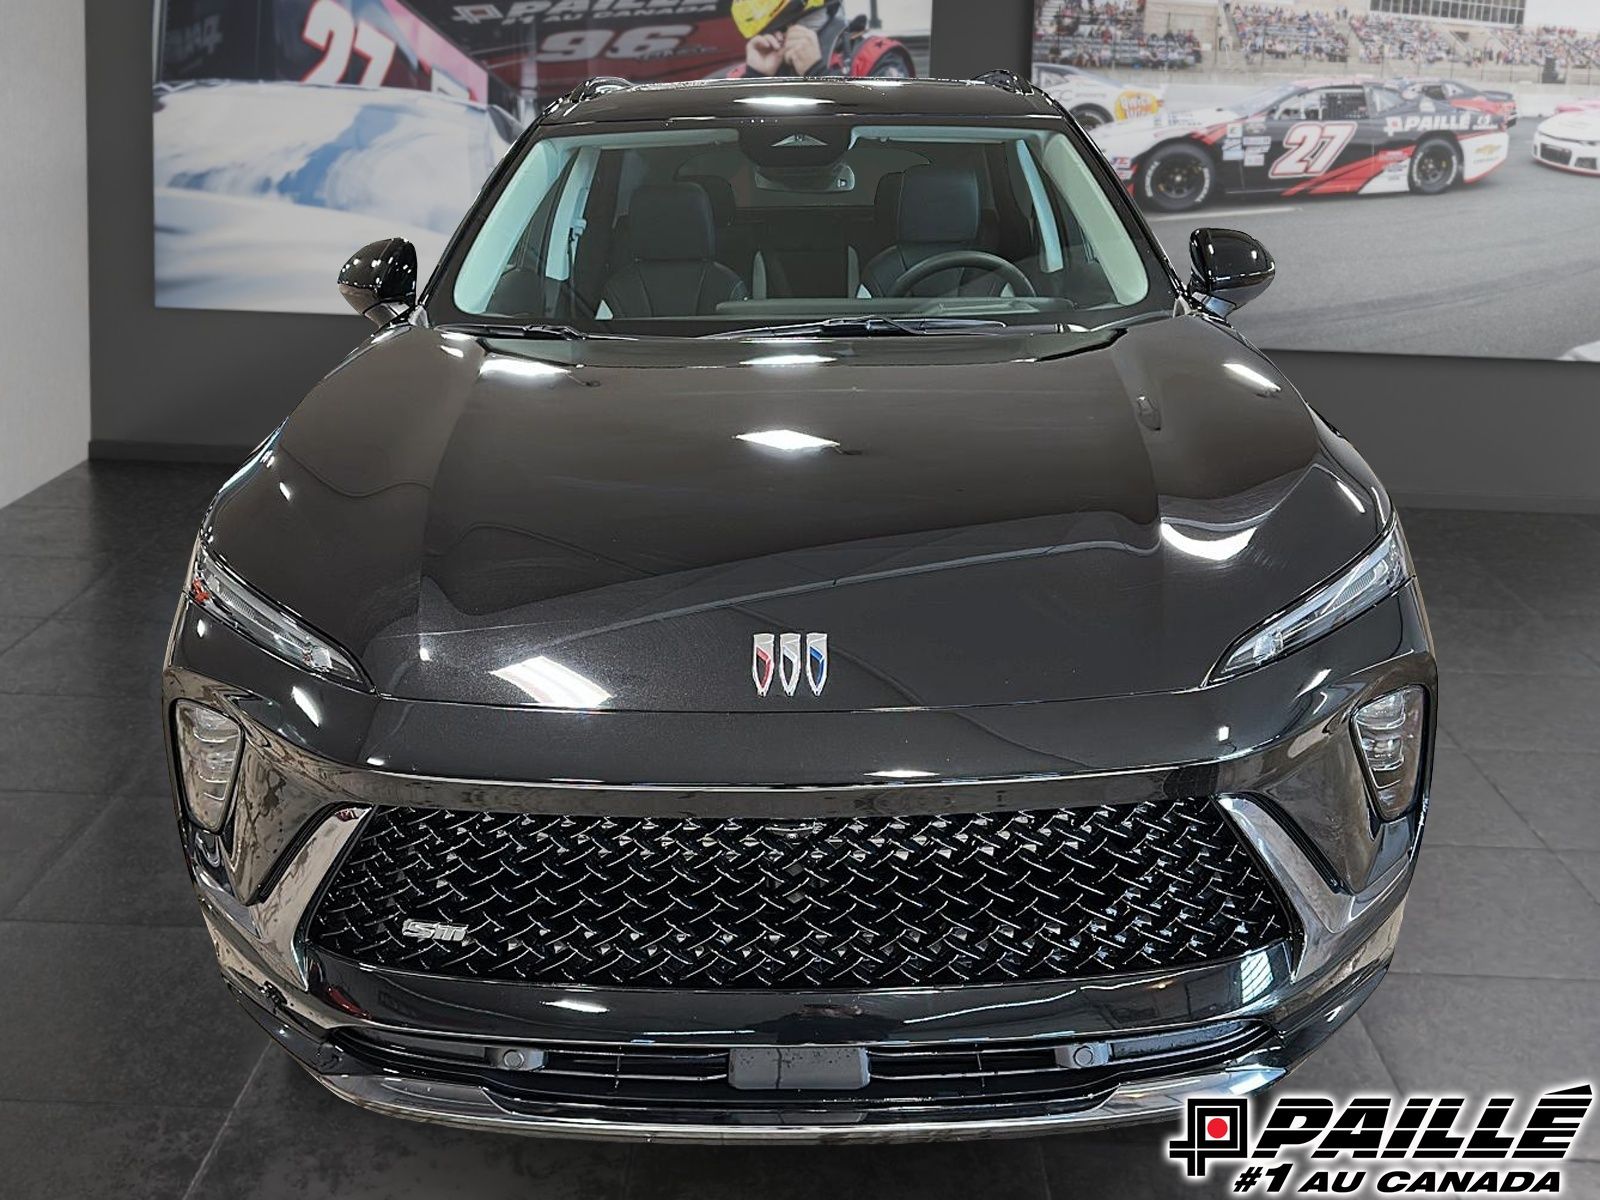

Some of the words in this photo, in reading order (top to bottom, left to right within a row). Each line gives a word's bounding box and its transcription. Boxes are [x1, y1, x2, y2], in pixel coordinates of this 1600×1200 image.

[543, 13, 583, 23] AU
[592, 4, 717, 19] CANADA
[301, 0, 396, 86] 27
[536, 24, 694, 63] 96
[1268, 120, 1359, 179] 27
